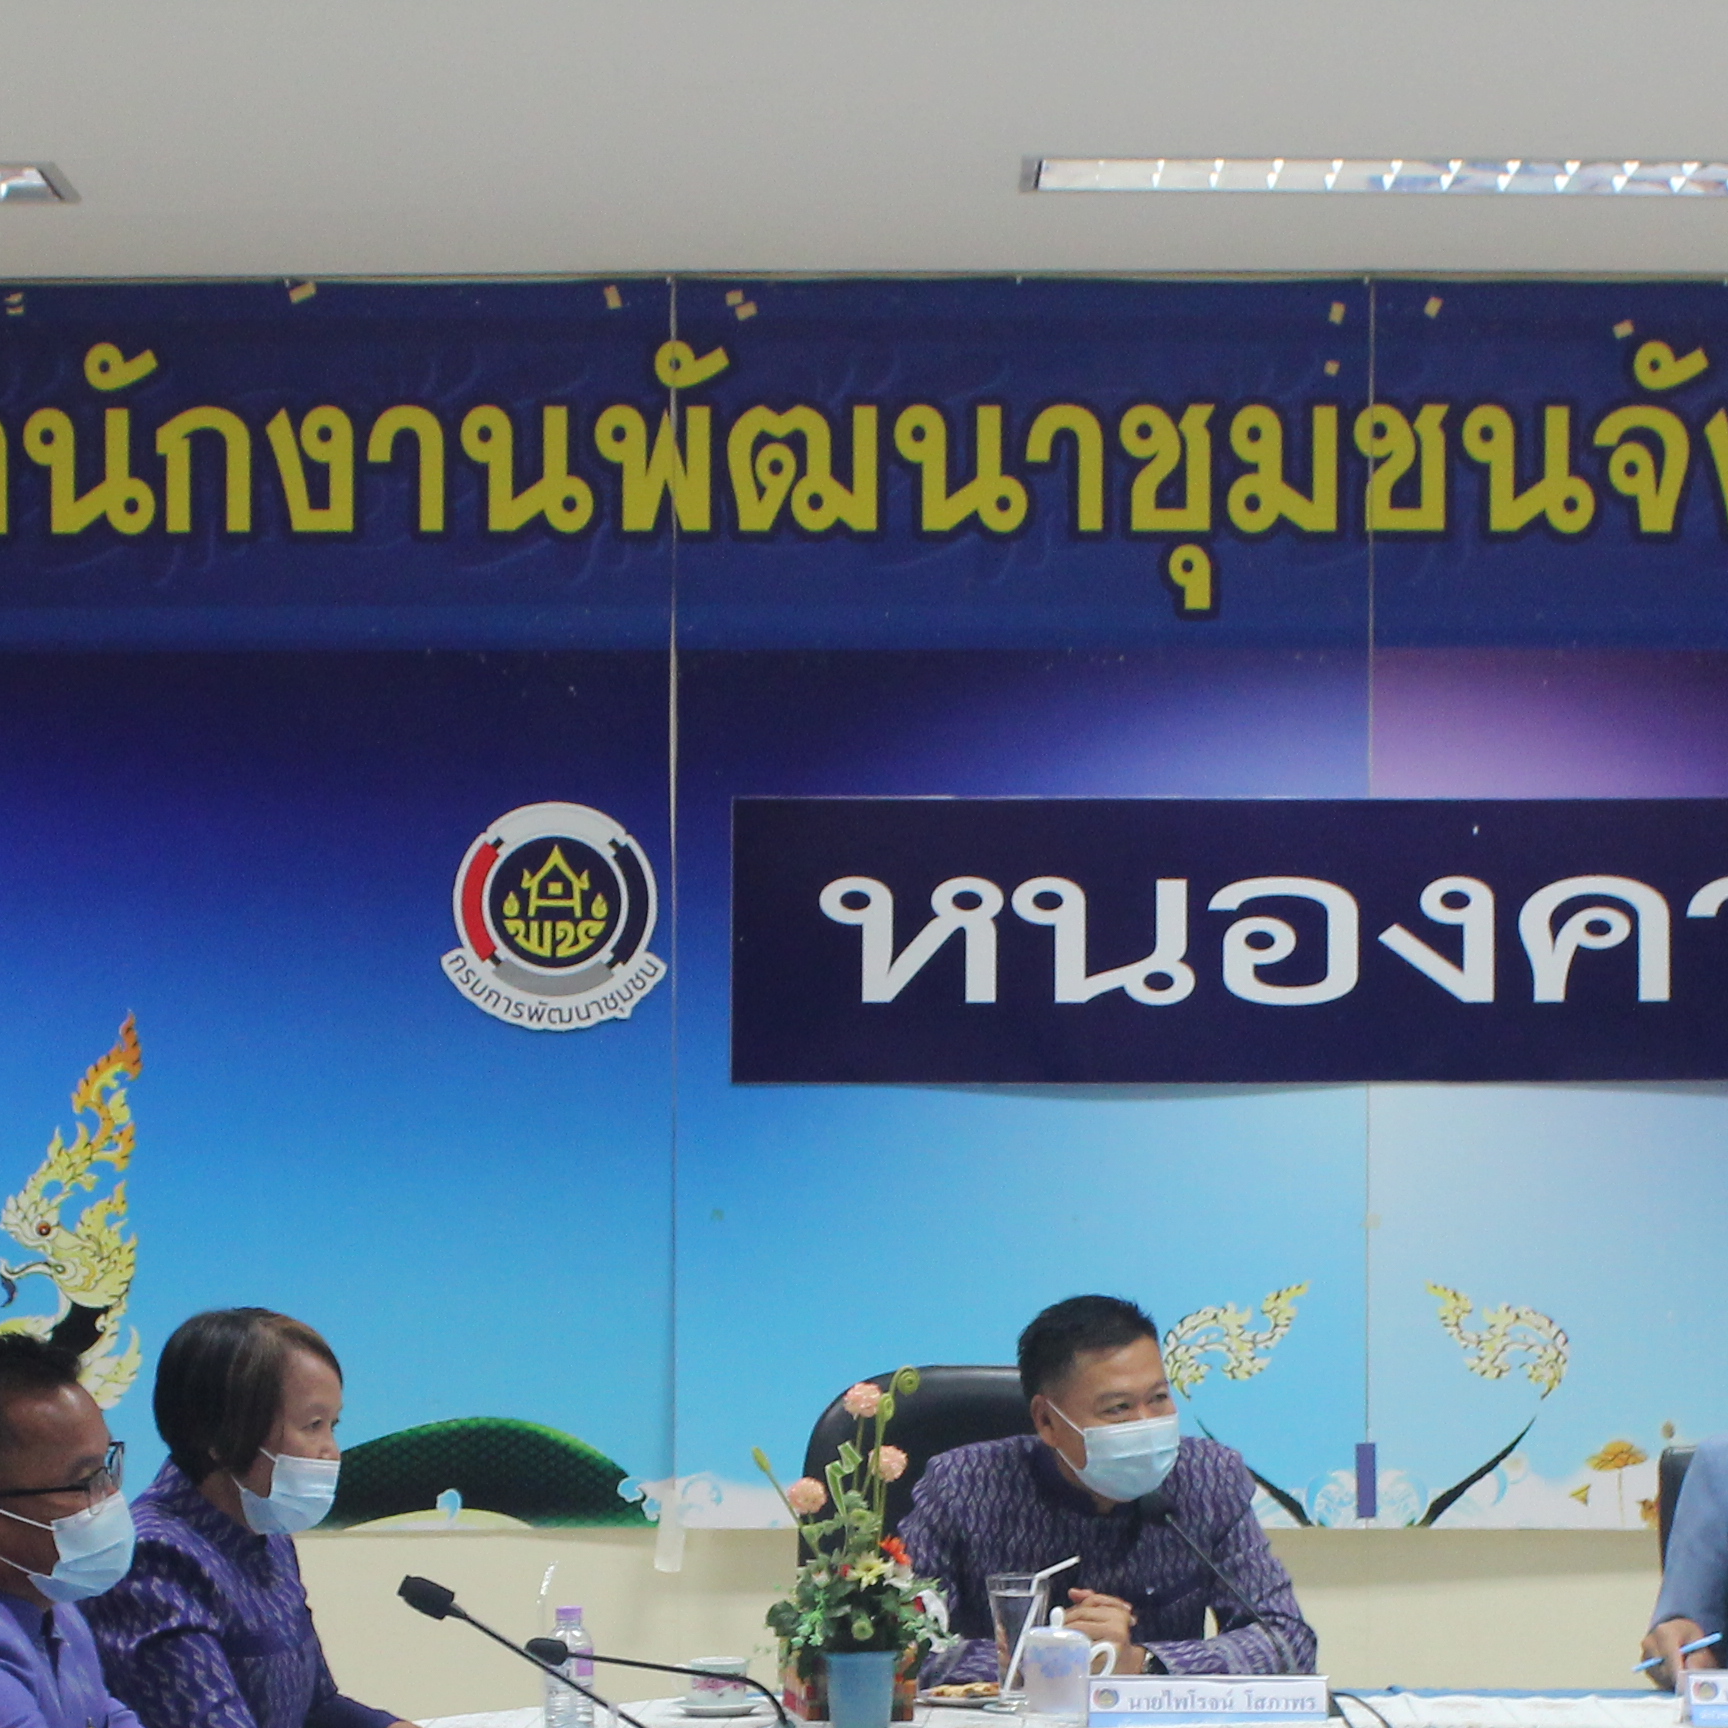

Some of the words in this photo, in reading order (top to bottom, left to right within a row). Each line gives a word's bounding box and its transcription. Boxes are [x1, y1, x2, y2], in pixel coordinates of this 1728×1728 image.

[447, 953, 661, 1025] กรมการพัฒนาชุมชน
